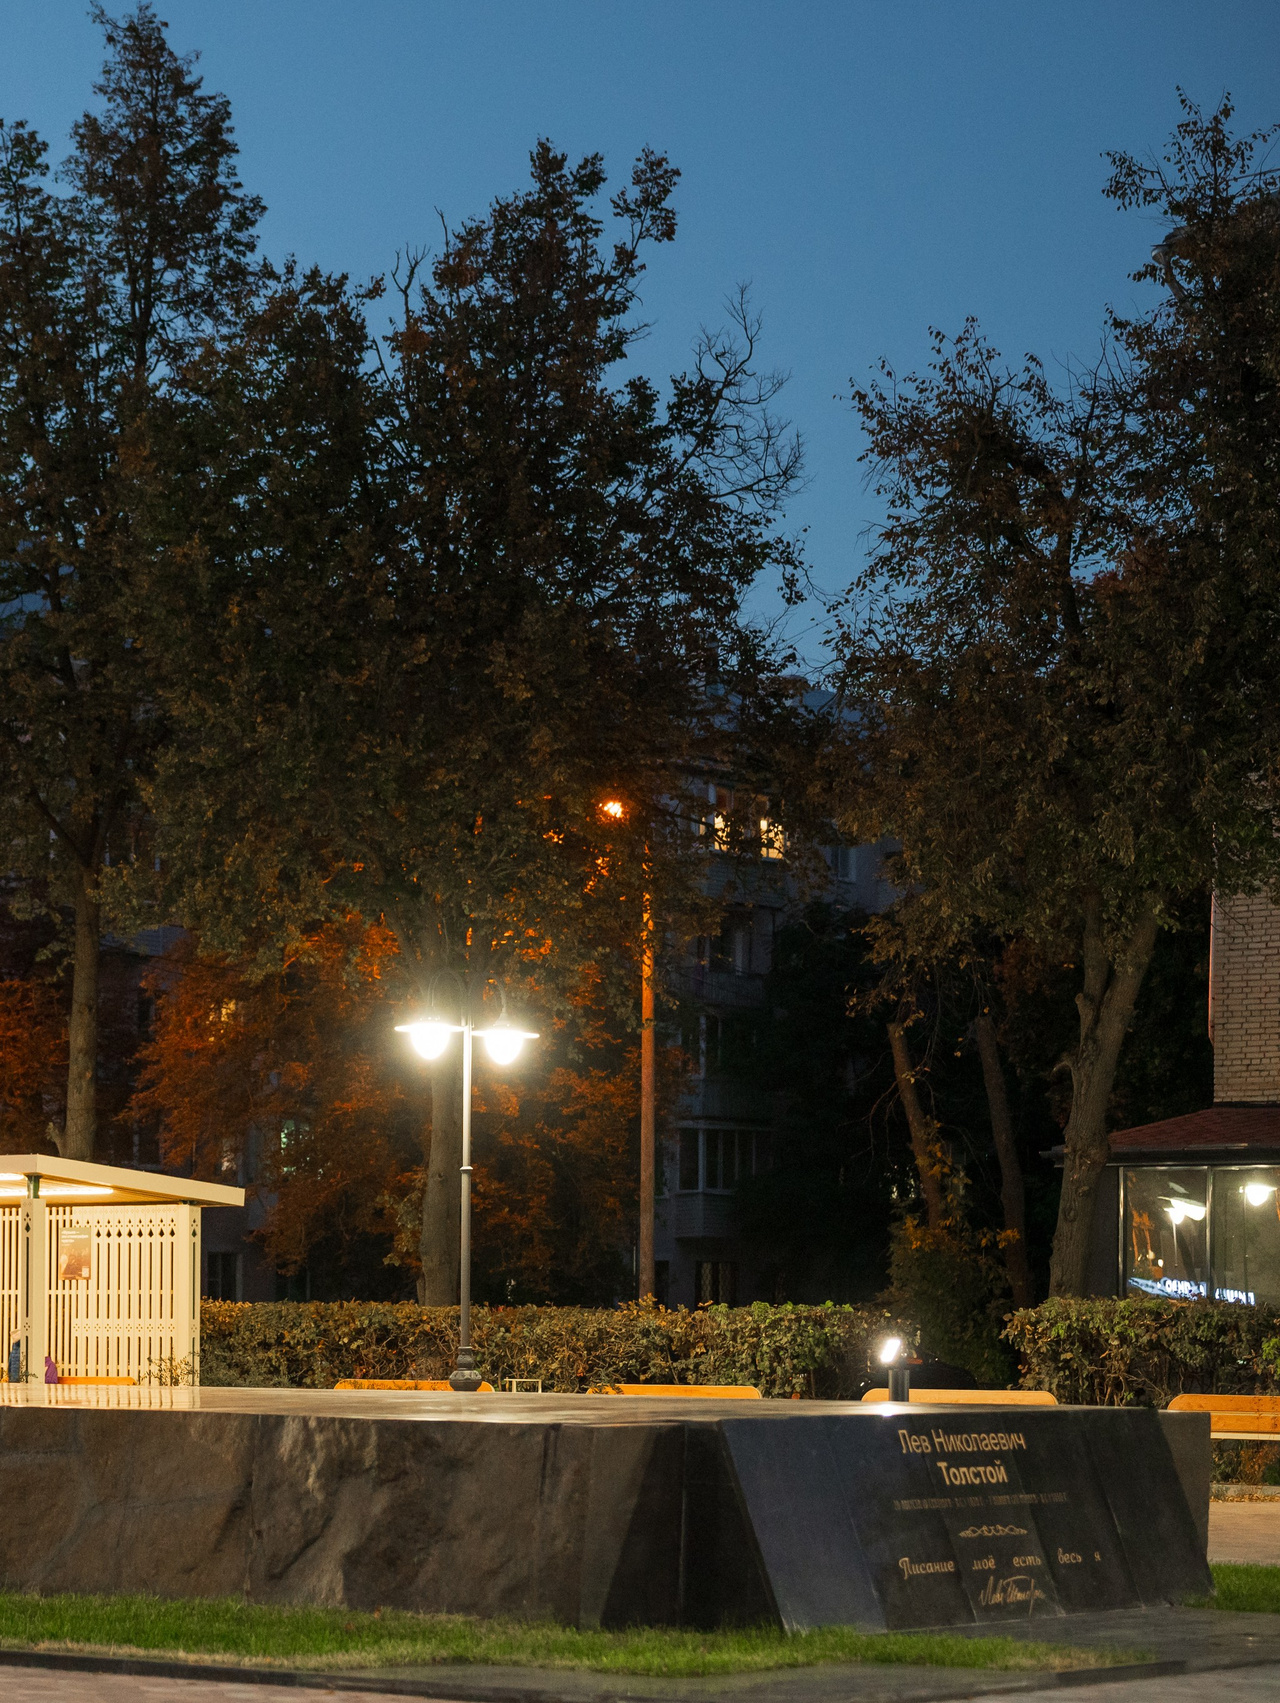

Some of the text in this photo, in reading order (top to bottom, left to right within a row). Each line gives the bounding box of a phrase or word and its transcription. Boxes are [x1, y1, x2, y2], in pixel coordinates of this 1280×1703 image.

[898, 1428, 1027, 1454] Лев Николаевич
[936, 1459, 1008, 1486] Толстой
[898, 1557, 956, 1580] Писание
[1012, 1555, 1042, 1568] есть
[1057, 1548, 1082, 1564] весь
